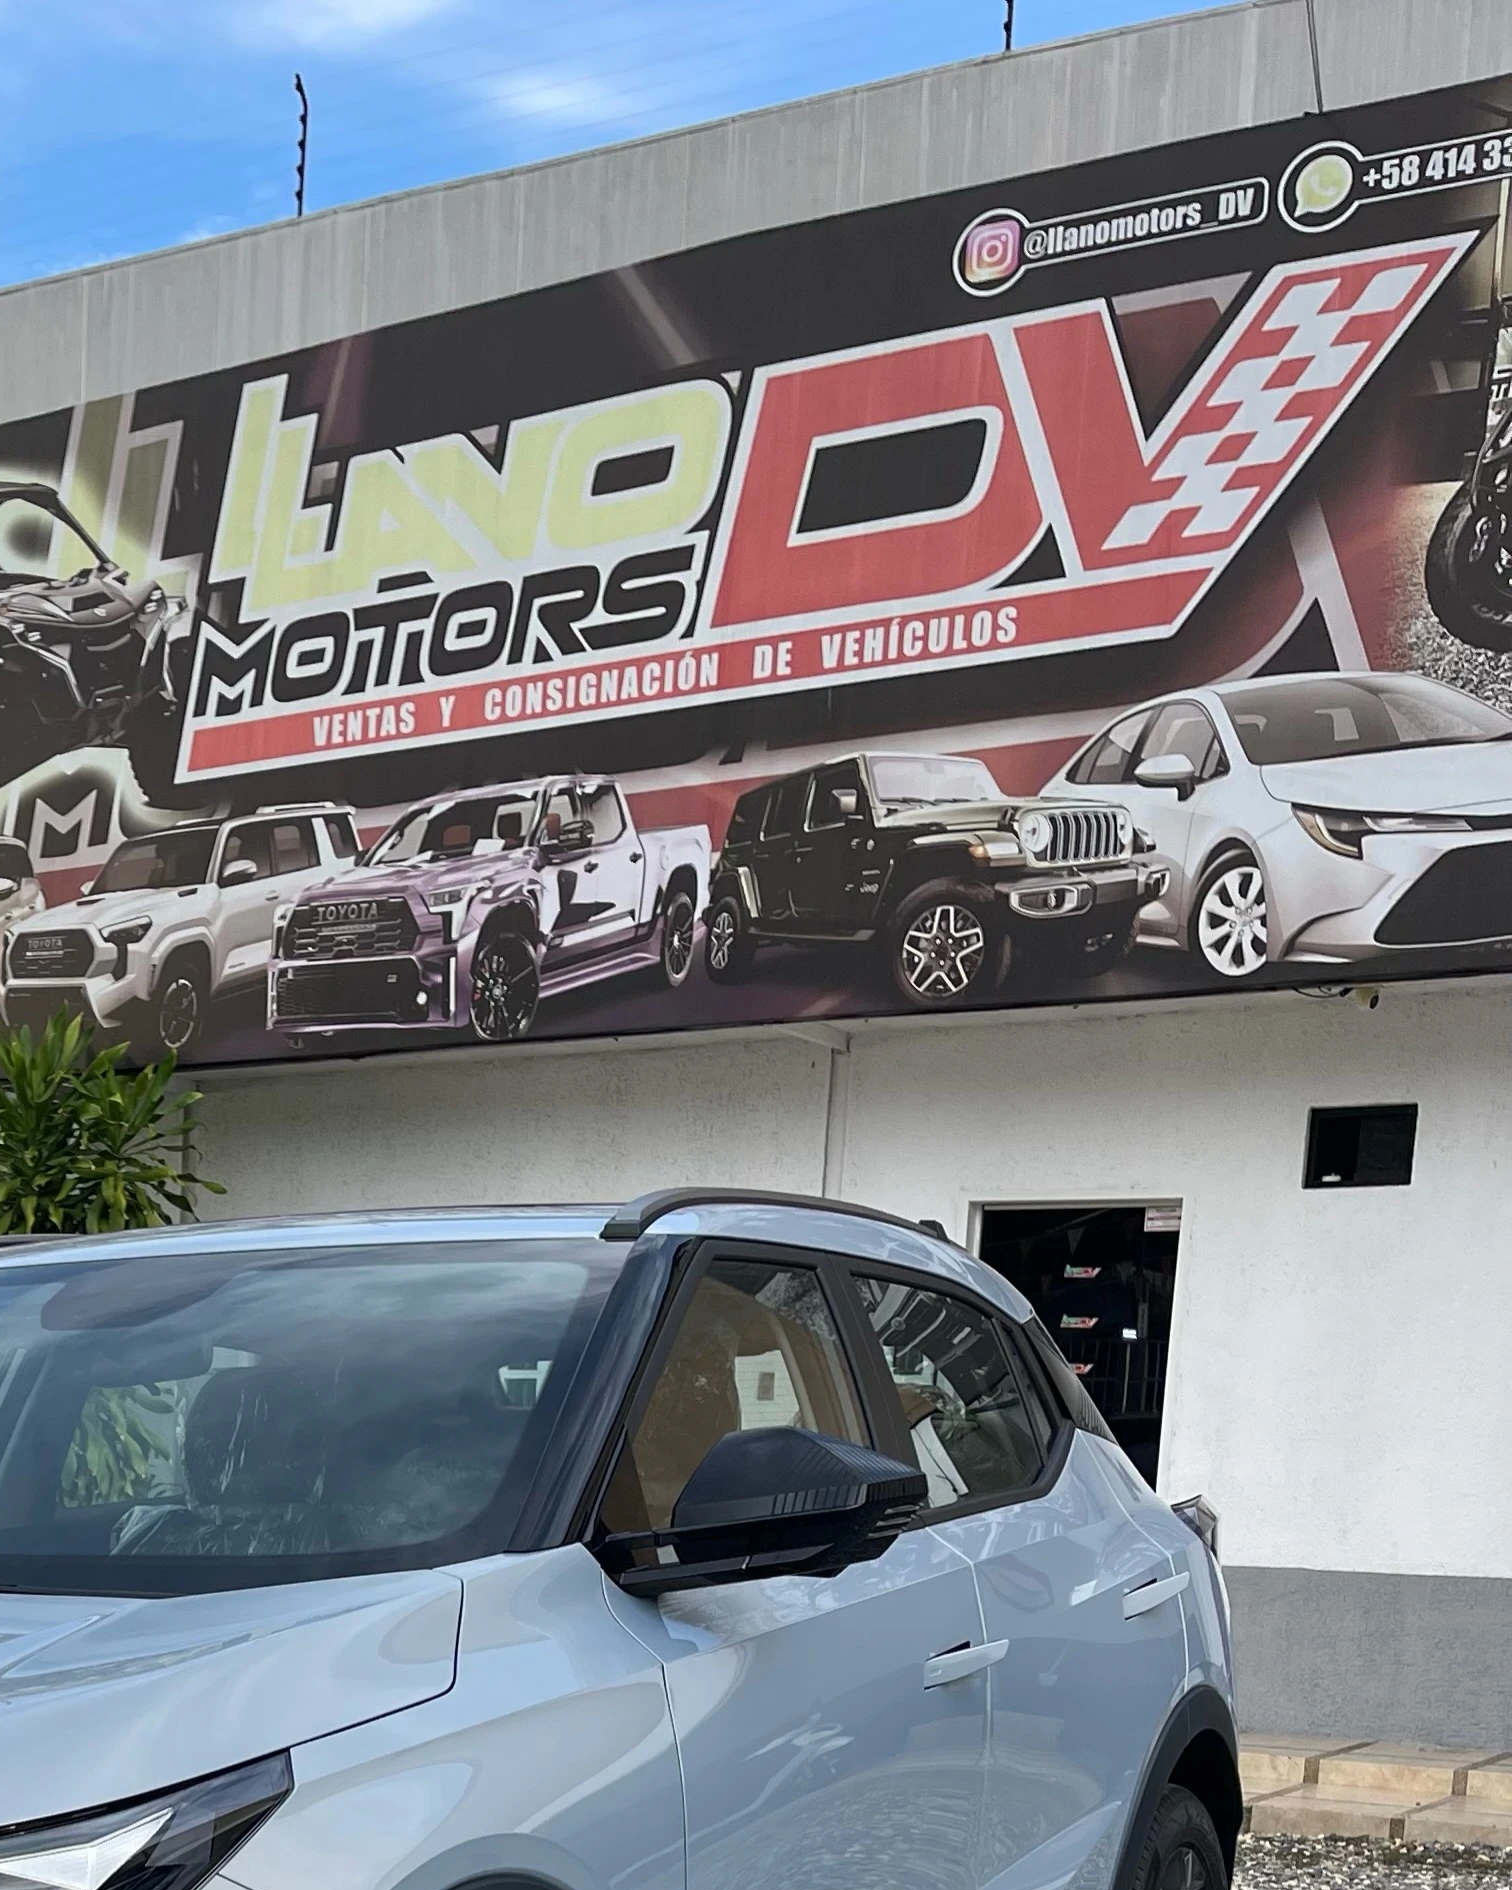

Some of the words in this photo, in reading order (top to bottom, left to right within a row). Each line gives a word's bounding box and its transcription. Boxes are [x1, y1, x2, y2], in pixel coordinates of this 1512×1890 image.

[1362, 154, 1420, 190] +58
[1425, 144, 1477, 181] 414
[210, 374, 731, 618] LLANO
[701, 228, 1478, 632] DV
[191, 543, 698, 722] MOTORS
[313, 701, 416, 747] VENTAS
[439, 694, 457, 728] Y
[484, 650, 719, 720] CONSIGNACIÓN
[752, 640, 793, 680] DE
[820, 605, 1019, 670] VEHÍCULOS
[317, 902, 378, 922] TOYOTA
